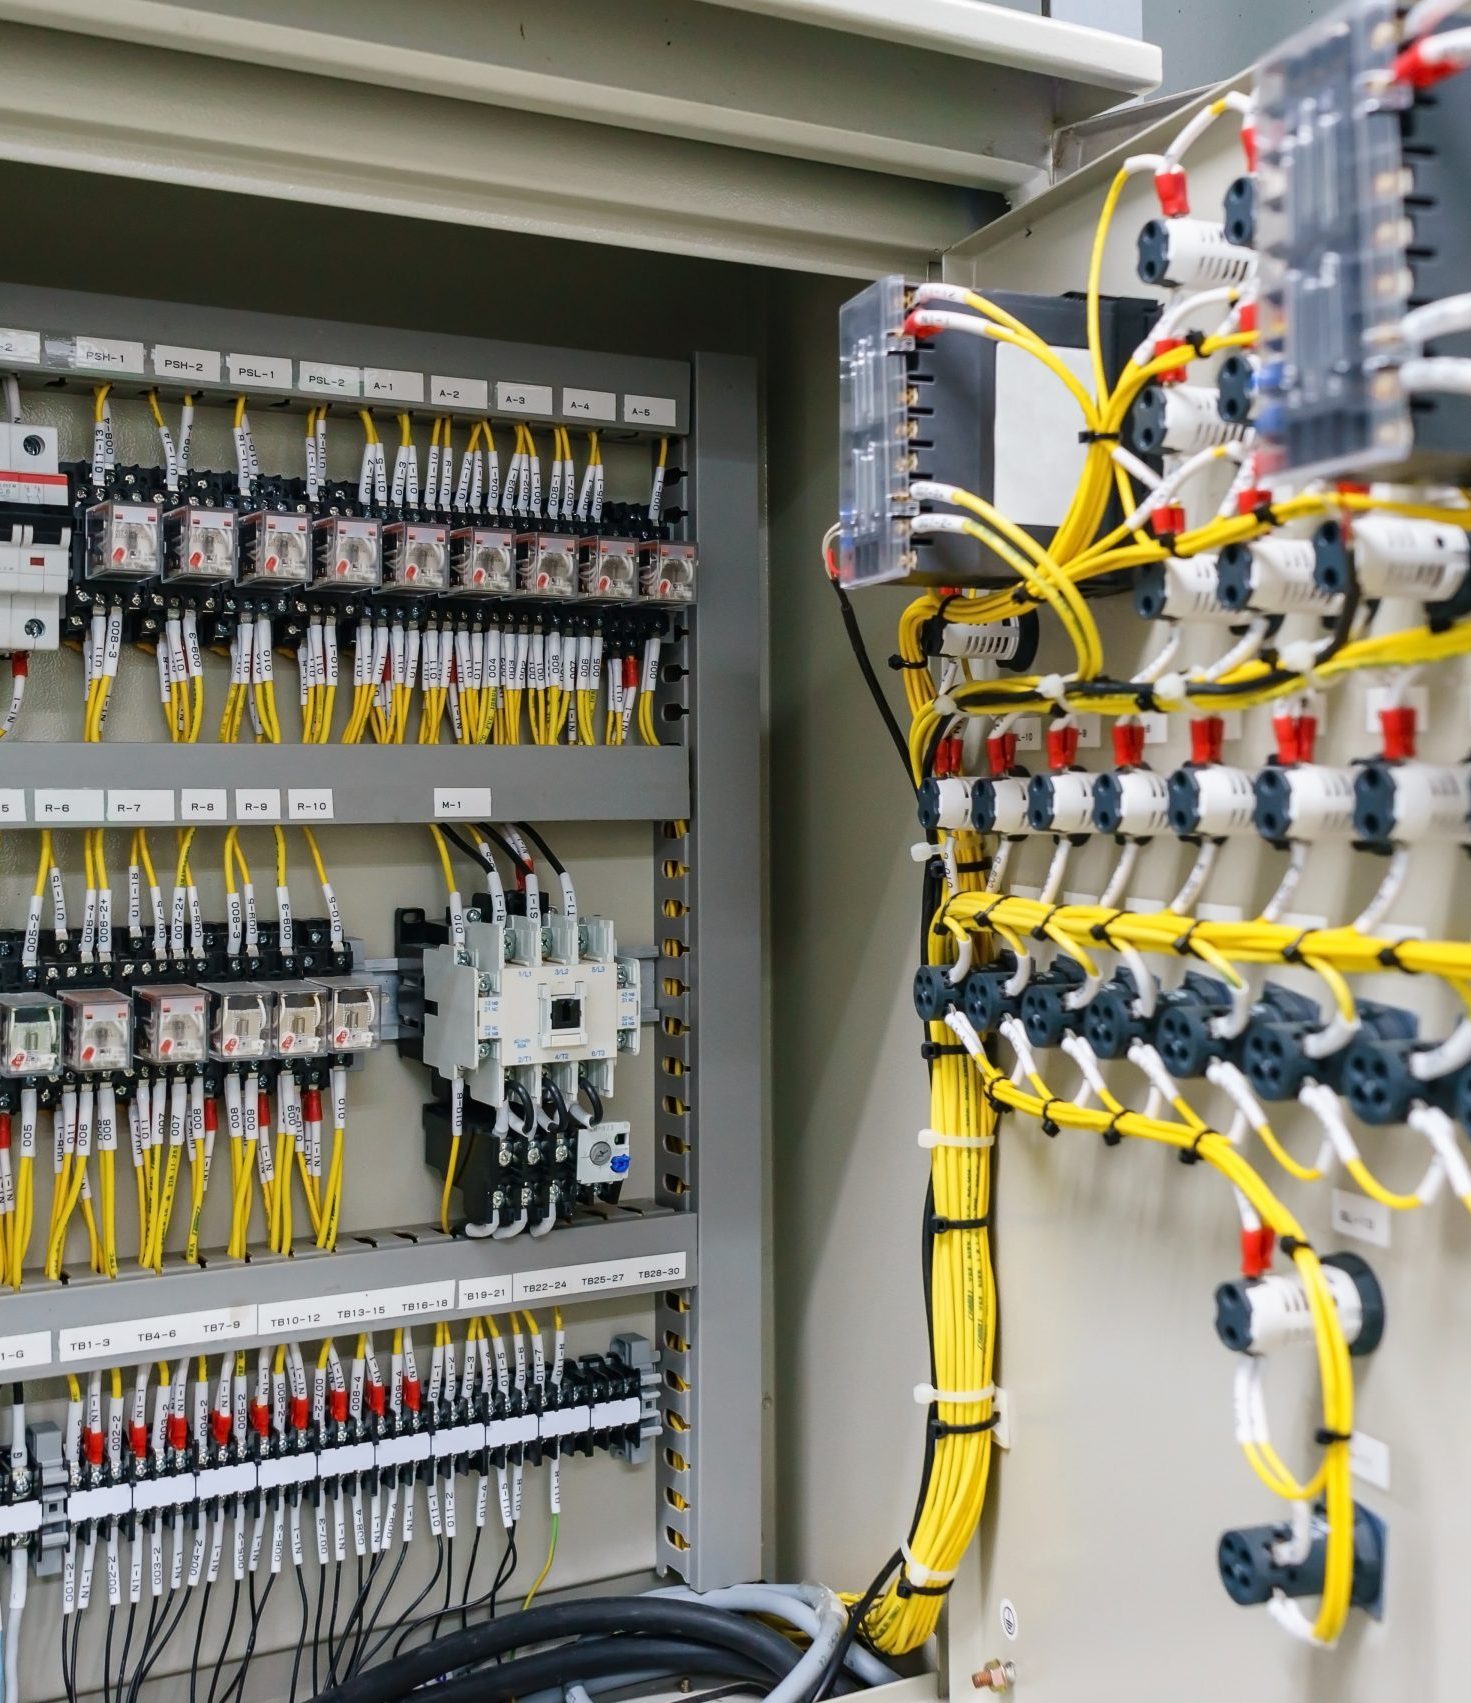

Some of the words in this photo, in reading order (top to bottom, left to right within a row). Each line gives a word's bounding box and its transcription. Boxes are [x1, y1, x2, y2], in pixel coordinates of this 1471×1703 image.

[86, 352, 124, 362] PSH-1
[164, 360, 203, 371] PSH-2
[239, 368, 274, 378] PSL-1
[309, 376, 344, 386] PSL-2
[374, 382, 392, 390] A-1
[440, 390, 460, 398] A-2
[506, 396, 526, 404] A-3
[571, 402, 590, 410] A-4
[109, 620, 120, 658] 008-3
[8, 698, 20, 722] N1-1
[27, 914, 40, 952] 005-2
[232, 902, 240, 939] 008-3
[523, 1281, 567, 1294] TB22-24
[582, 1274, 624, 1286] TB25-27
[638, 1268, 680, 1278] TB28-30
[464, 1289, 505, 1300] B19-21
[271, 1314, 320, 1328] TB10-12
[338, 1306, 386, 1318] TB13-15
[402, 1300, 448, 1312] TB16-18
[70, 1338, 110, 1352] TB1-3
[138, 1330, 176, 1342] TB4-6
[203, 1321, 240, 1333] TB7-9
[332, 1362, 344, 1390] N1-1
[369, 1356, 382, 1383] N1-1
[406, 1352, 417, 1378] N1-1
[296, 1368, 306, 1394] N1-1
[136, 1389, 144, 1418] N1-1
[82, 1568, 92, 1598] N1-1
[132, 1563, 140, 1592] N1-1
